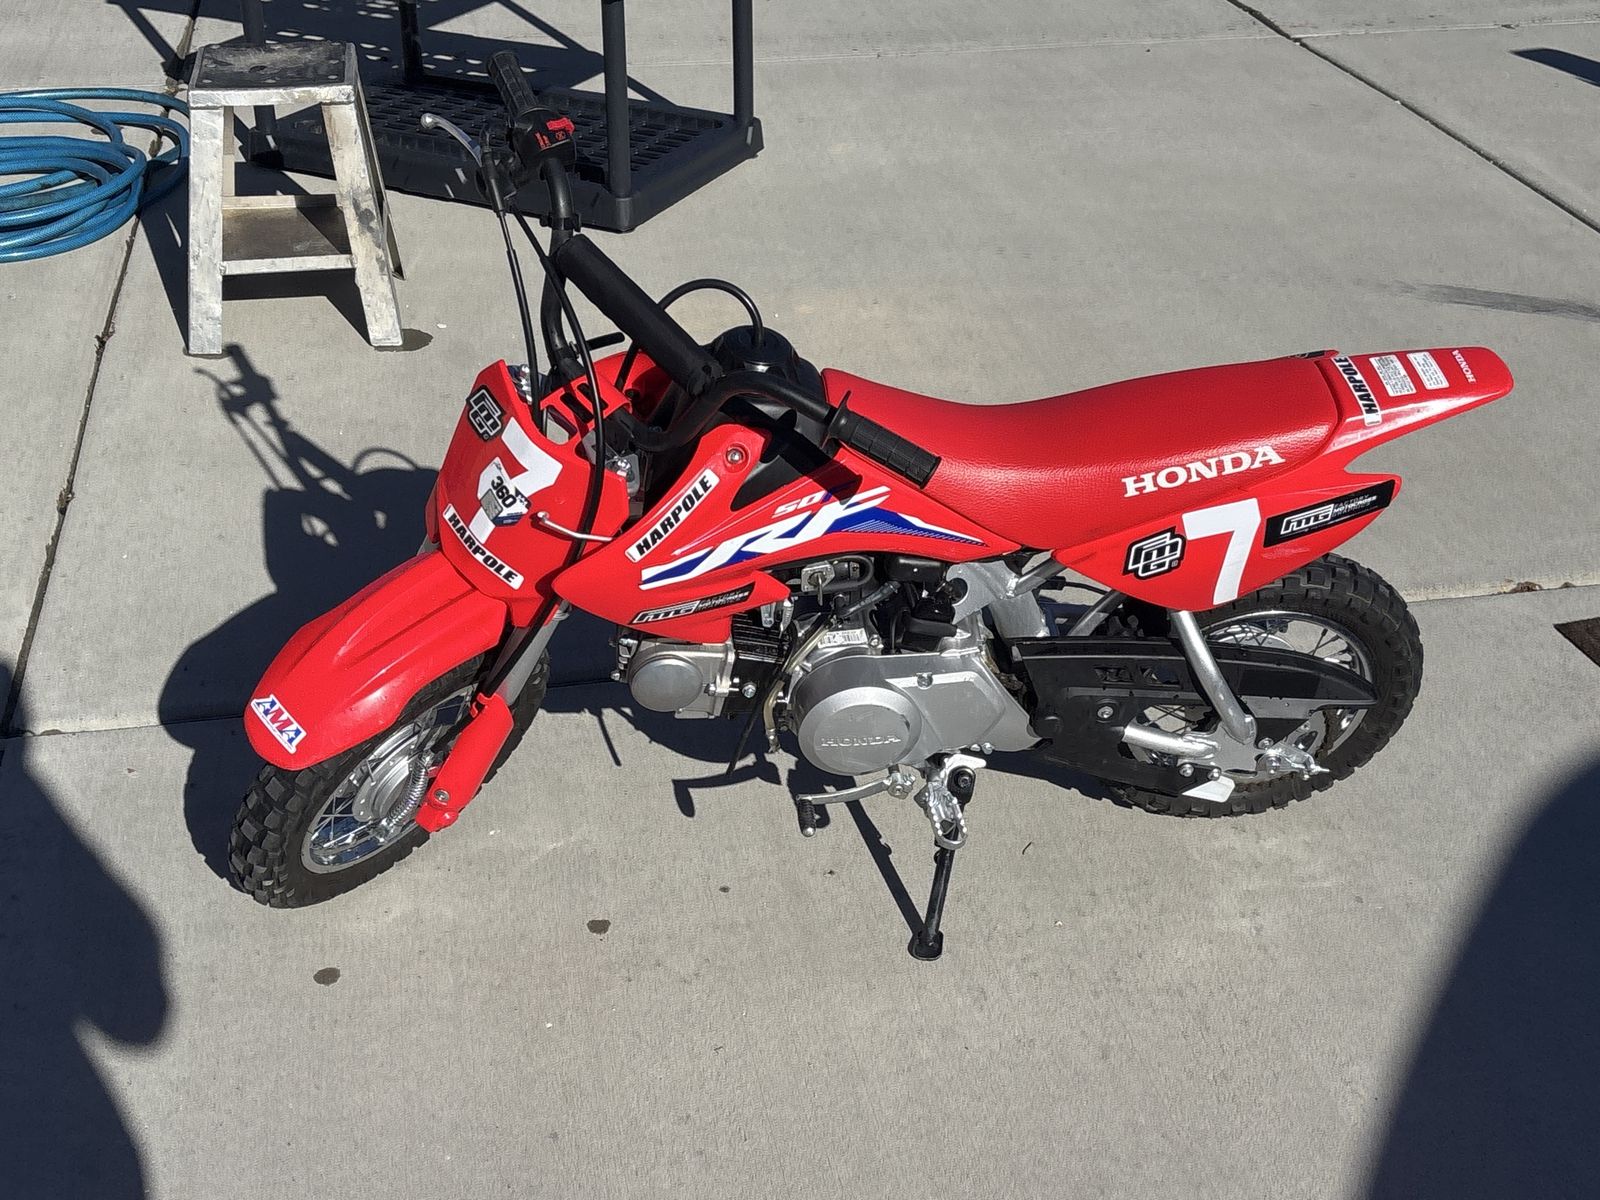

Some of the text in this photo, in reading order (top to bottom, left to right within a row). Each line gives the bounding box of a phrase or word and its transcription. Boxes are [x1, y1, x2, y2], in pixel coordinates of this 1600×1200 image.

[1335, 356, 1379, 414] HARPOLE
[1453, 350, 1477, 384] HONDA
[491, 475, 517, 509] 360
[1122, 446, 1286, 497] HONDA
[636, 475, 713, 556] HARPOLE
[448, 512, 518, 583] HARPOLE
[1182, 497, 1261, 605] 7
[256, 698, 302, 744] AMA
[821, 735, 901, 747] HONDA
